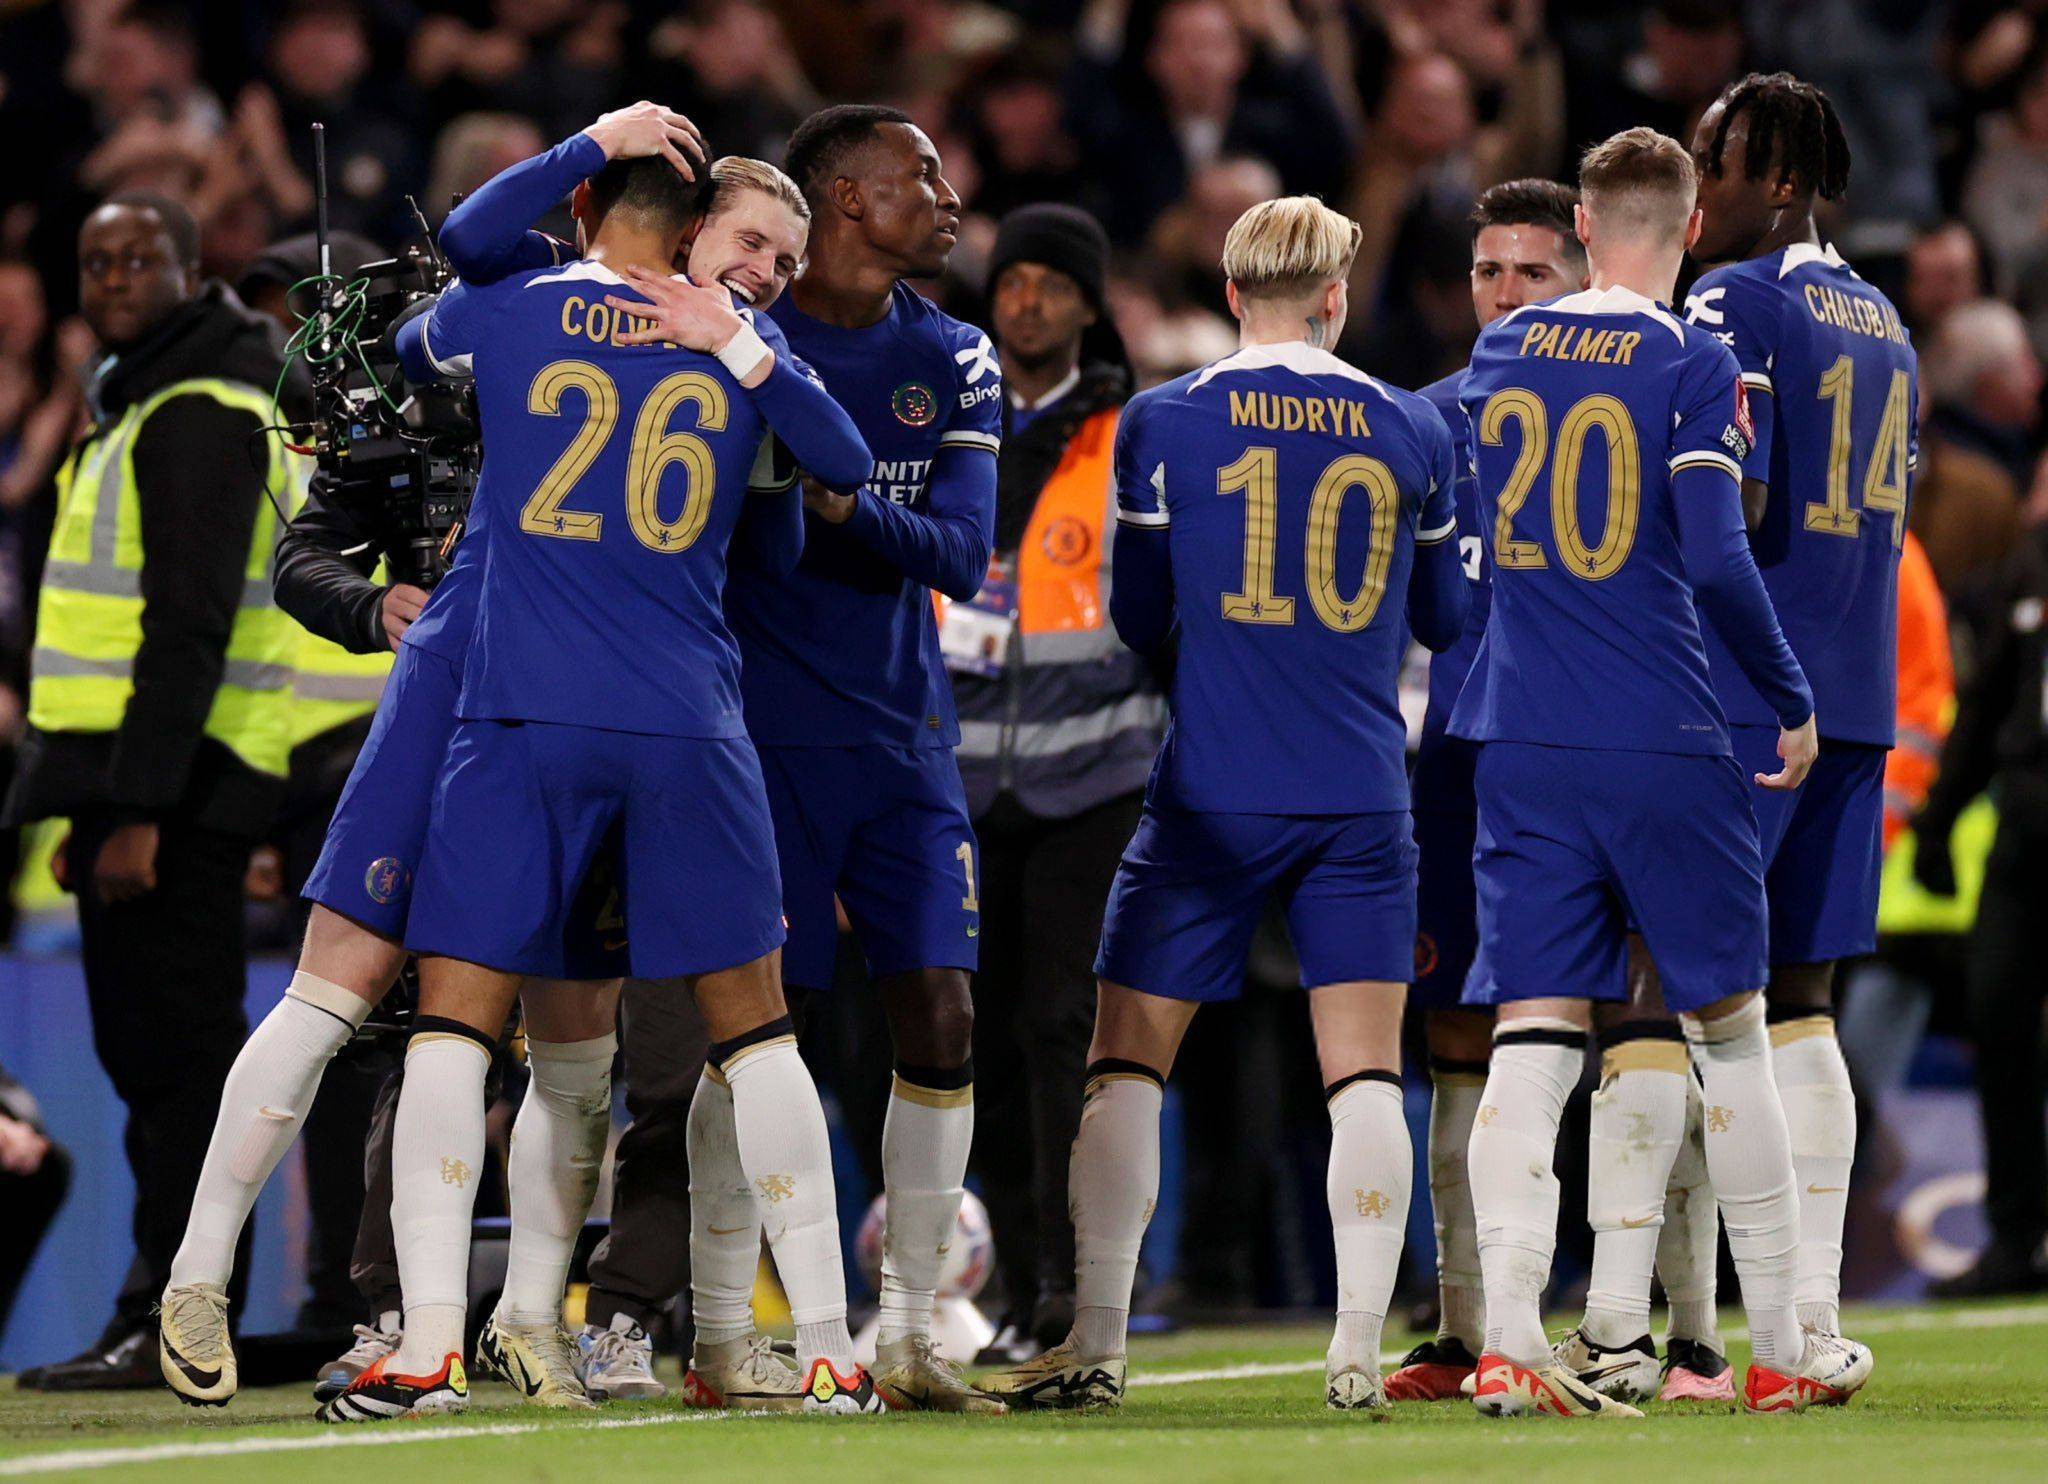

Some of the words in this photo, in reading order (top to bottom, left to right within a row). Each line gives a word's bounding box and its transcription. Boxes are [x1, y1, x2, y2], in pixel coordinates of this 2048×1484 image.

[1519, 321, 1642, 366] PALMER
[1804, 283, 1907, 346] CHALOBAH
[519, 359, 730, 554] 26
[1228, 390, 1371, 438] MUDRYK
[1480, 387, 1641, 582] 20
[1803, 354, 1910, 548] 14
[1216, 446, 1400, 633] 10
